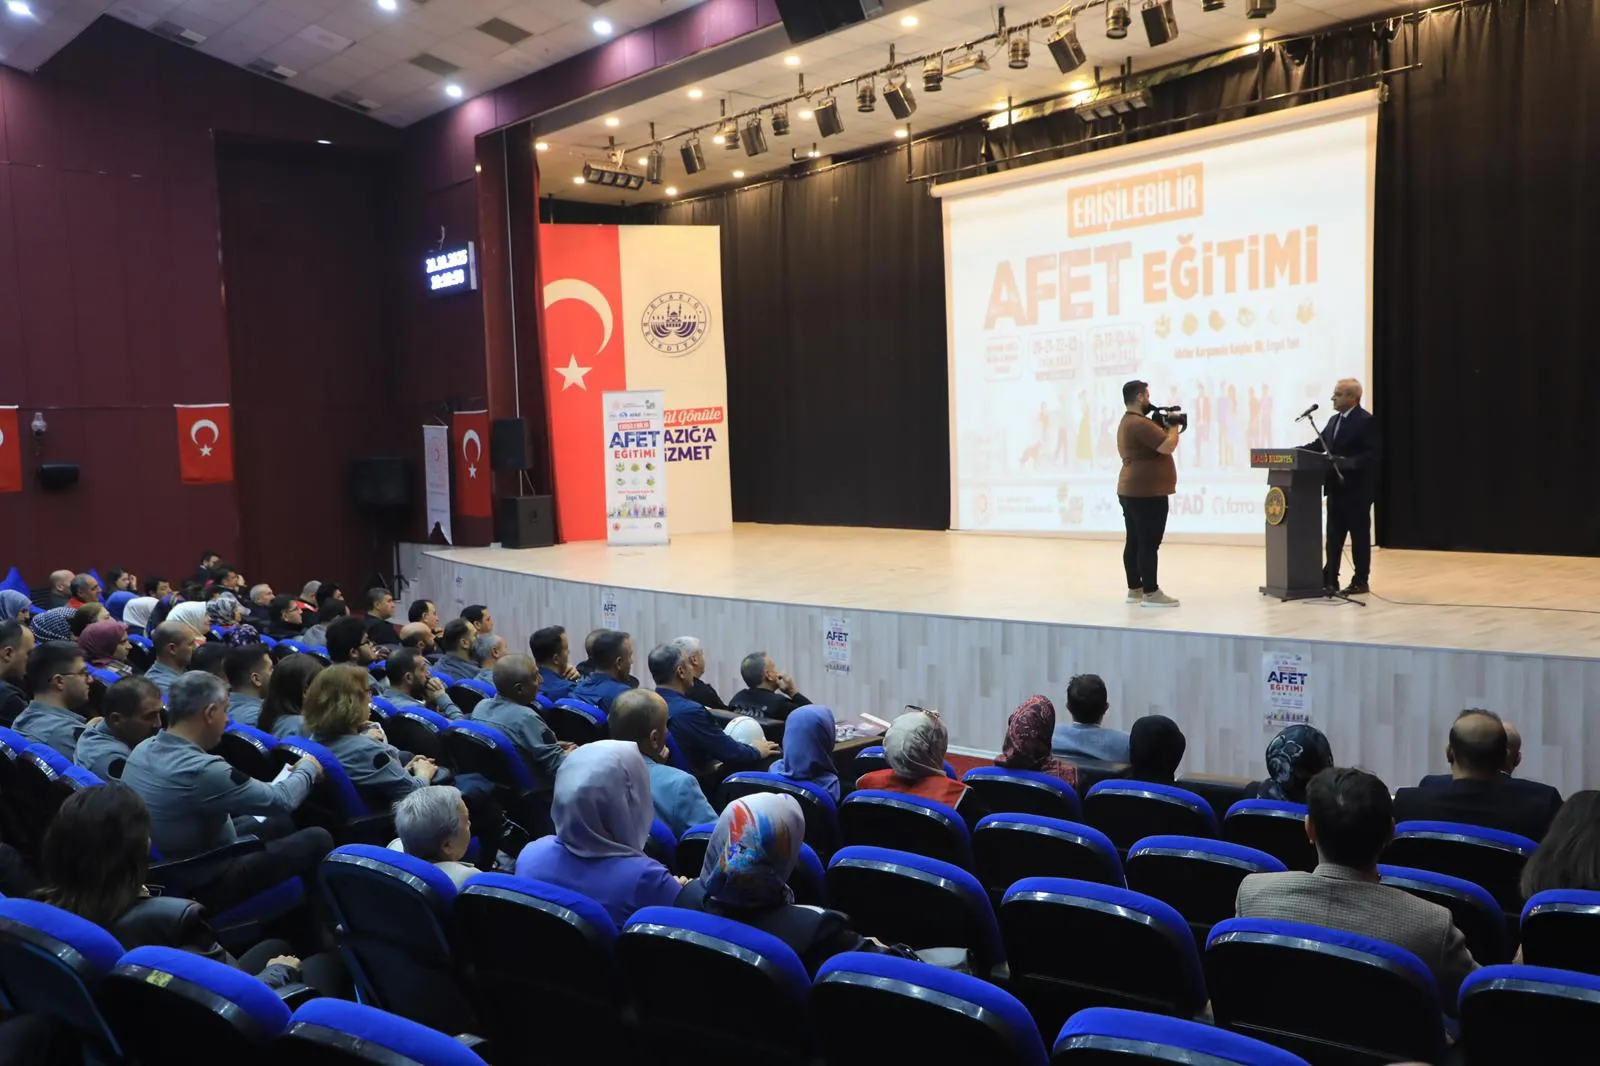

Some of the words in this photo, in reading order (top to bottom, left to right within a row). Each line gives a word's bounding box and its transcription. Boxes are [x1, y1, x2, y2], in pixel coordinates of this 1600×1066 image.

[1073, 172, 1197, 231] ERİŞİLEBİLİR
[984, 242, 1132, 330] AFET
[1142, 224, 1319, 304] EĞİTİMİ
[679, 410, 721, 426] Gönüle
[609, 431, 660, 448] AFET
[664, 426, 716, 444] AZIĞ'A
[614, 448, 656, 459] EĞİTİMİ
[664, 445, 712, 462] İZMET
[826, 631, 849, 641] AFET
[1267, 671, 1308, 685] AFET
